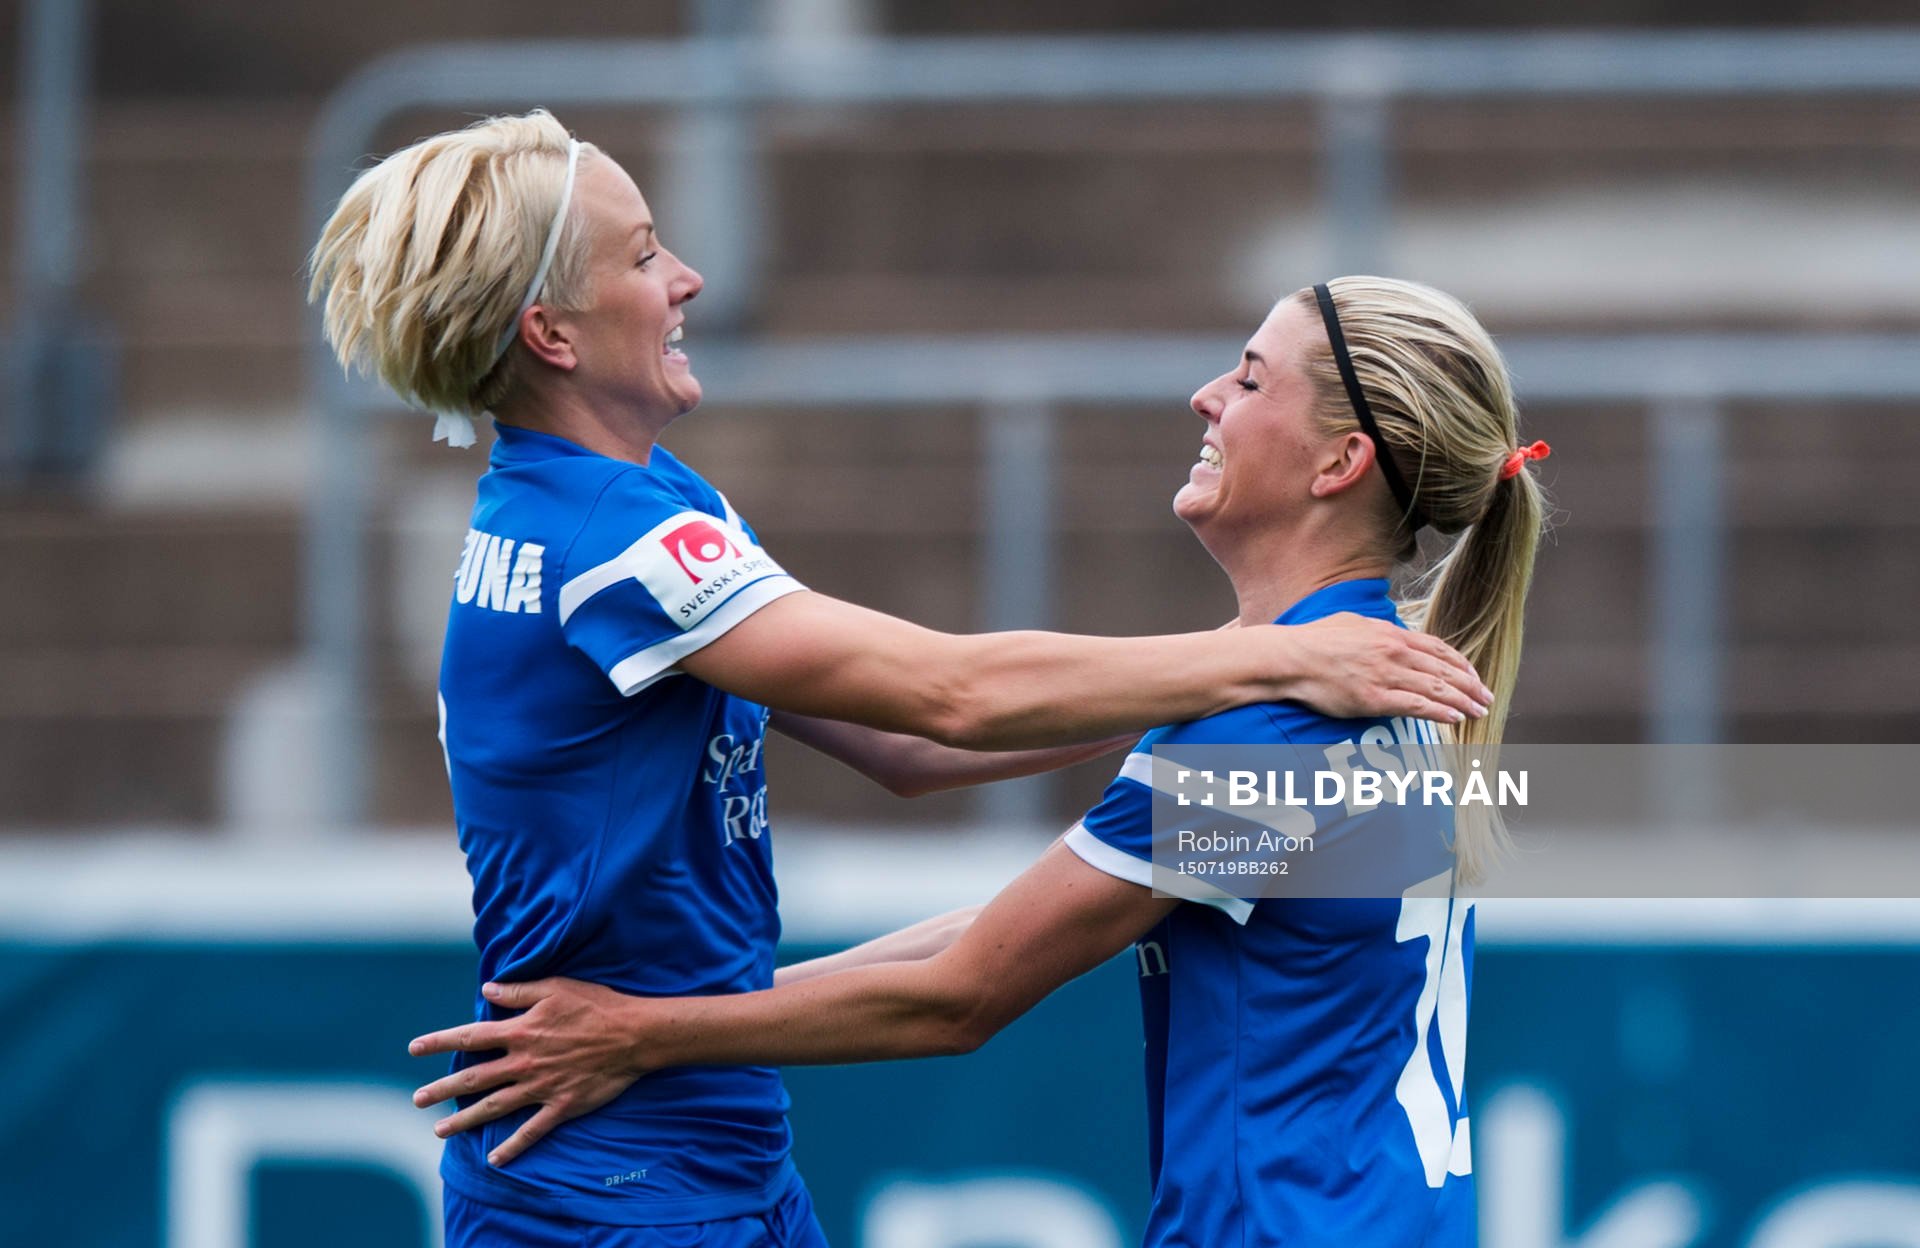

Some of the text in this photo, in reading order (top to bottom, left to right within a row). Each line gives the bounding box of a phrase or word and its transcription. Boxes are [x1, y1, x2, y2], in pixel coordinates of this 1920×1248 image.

[454, 528, 545, 614] UNA
[680, 568, 742, 618] SVENSKA
[605, 1169, 648, 1187] DRI-FIT
